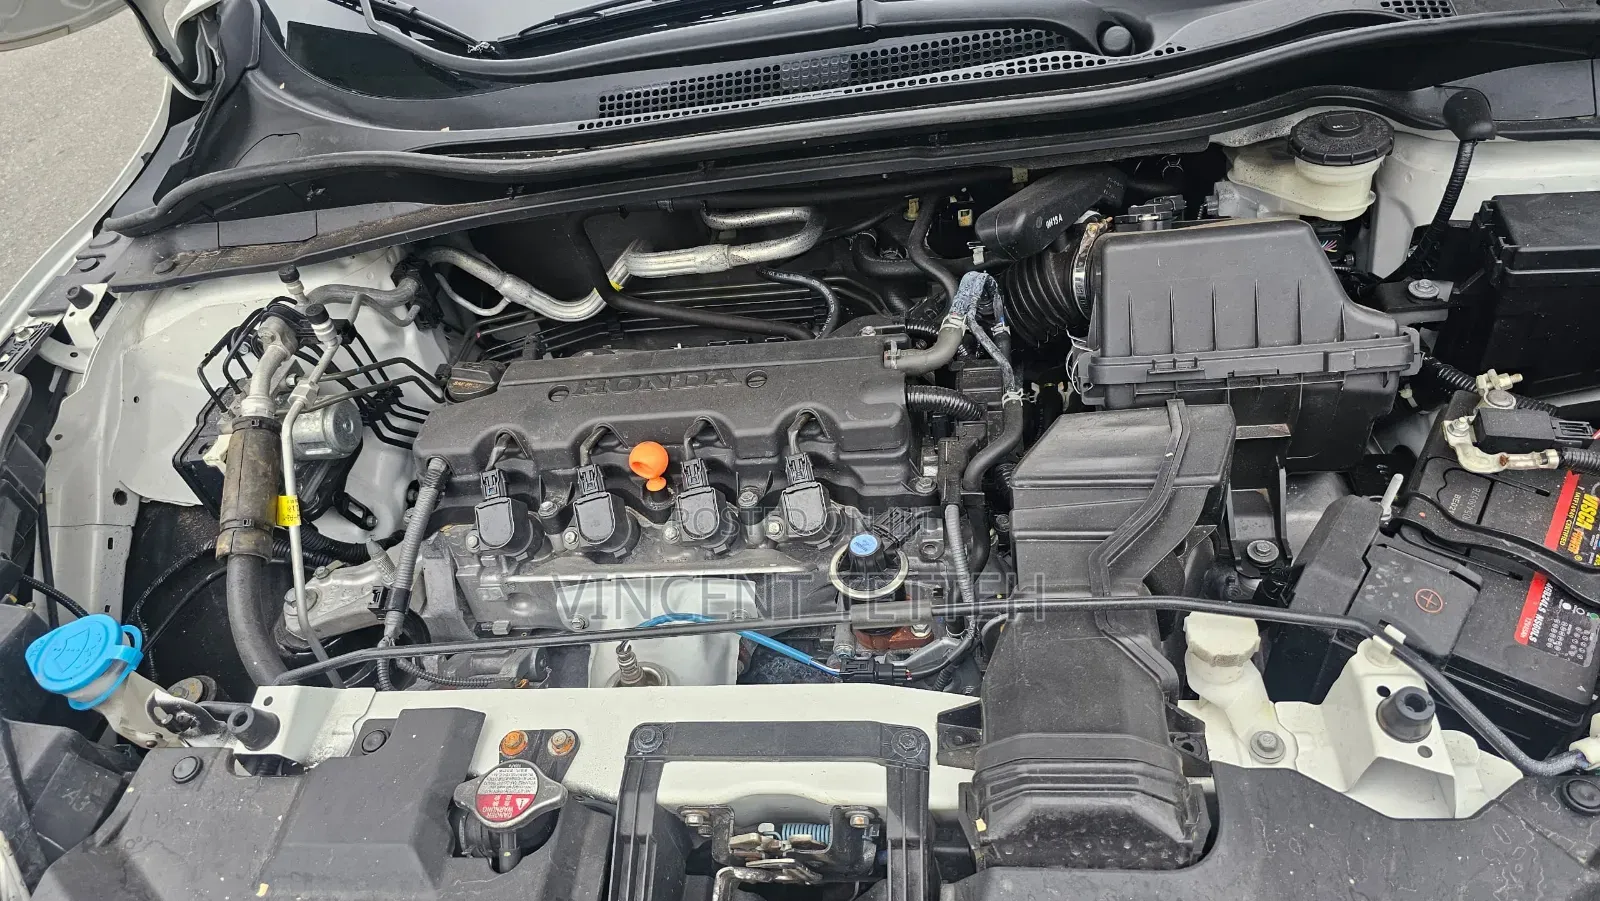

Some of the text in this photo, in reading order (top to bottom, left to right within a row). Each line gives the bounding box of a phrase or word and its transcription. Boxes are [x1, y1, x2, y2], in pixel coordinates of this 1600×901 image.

[572, 369, 742, 396] HONDA
[1576, 494, 1599, 530] VISCA
[1529, 582, 1554, 643] 46B24LS NS60LS
